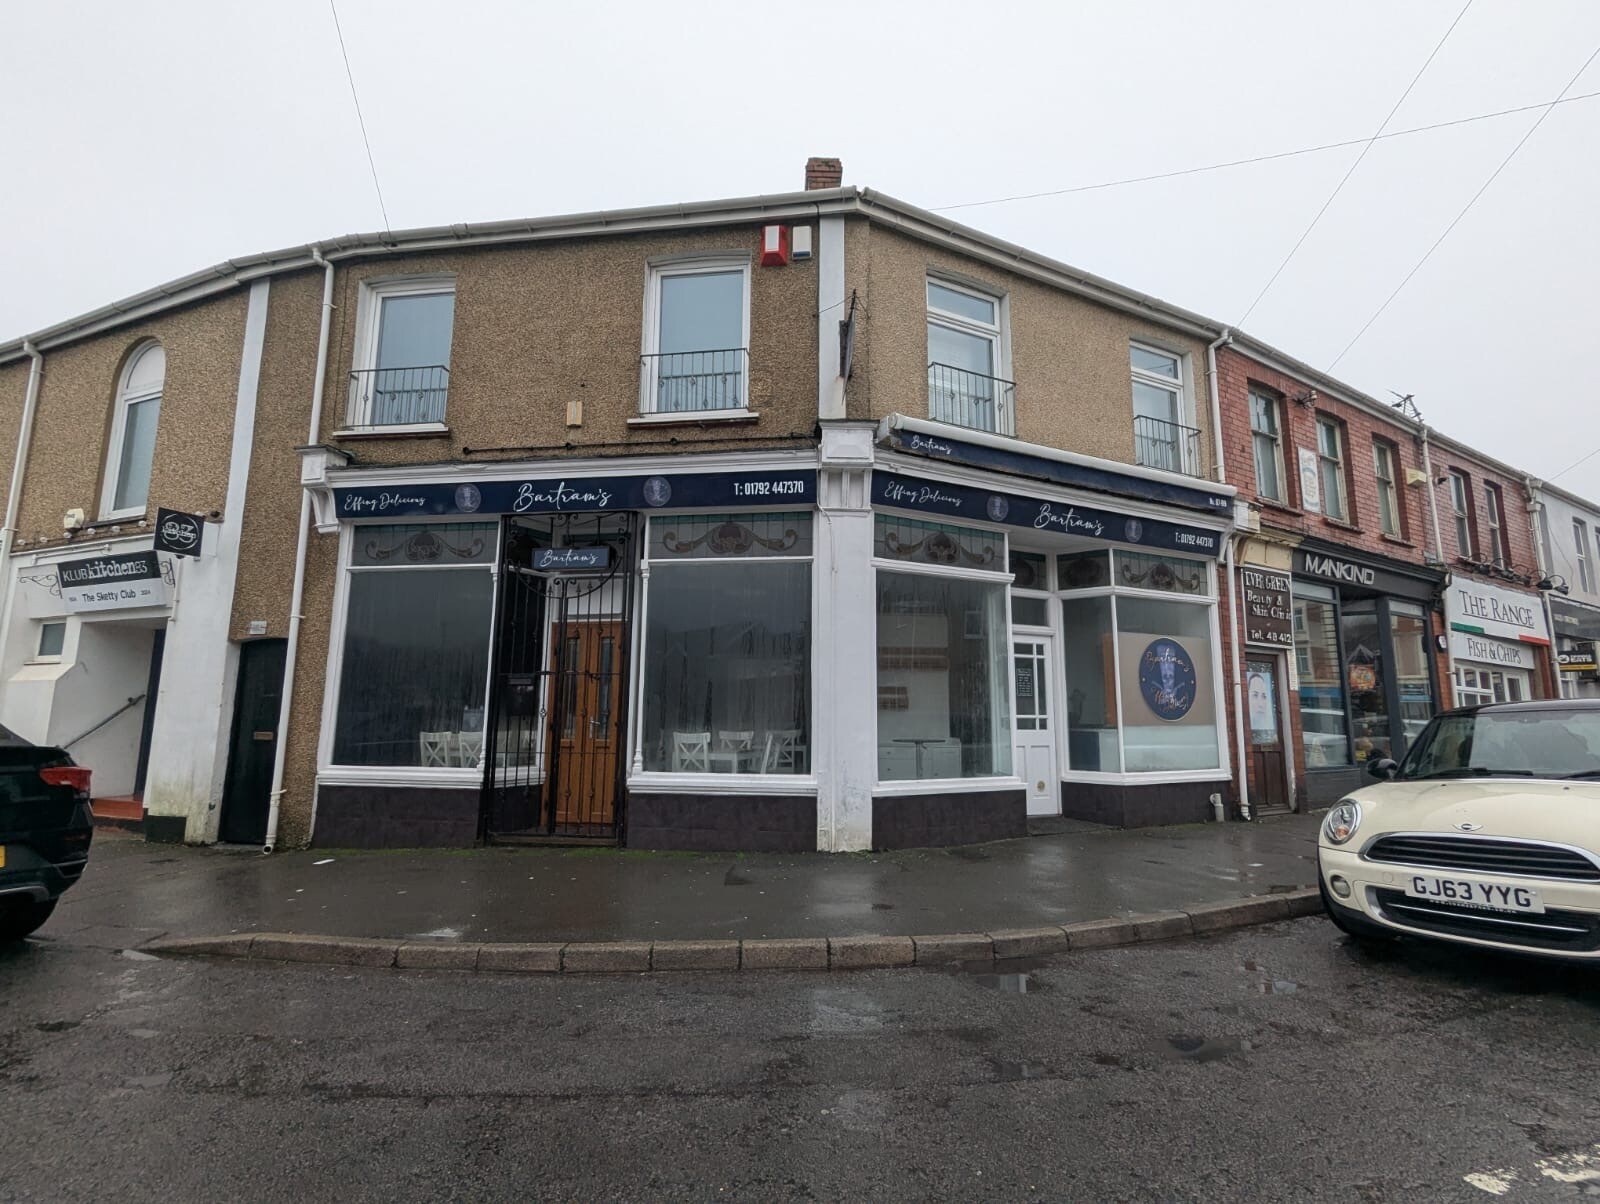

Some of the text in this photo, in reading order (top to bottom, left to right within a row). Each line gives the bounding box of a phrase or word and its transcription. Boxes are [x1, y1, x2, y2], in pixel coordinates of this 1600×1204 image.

[513, 481, 612, 512] Bartram's
[744, 482, 770, 496] 01792
[772, 480, 804, 495] 447370
[884, 481, 918, 503] Effing
[344, 494, 377, 511] Effing
[1033, 503, 1105, 535] Bartram's
[539, 549, 599, 566] Bartram's
[1305, 553, 1375, 585] MANKIND
[82, 593, 95, 603] The
[120, 589, 136, 599] Club
[1247, 590, 1283, 608] Beauty &
[1252, 603, 1269, 618] Skin
[1459, 589, 1488, 617] THE
[1490, 597, 1534, 626] RANGE
[1467, 637, 1522, 665] FISH & CHIPS
[1412, 876, 1473, 901] GJ63
[1479, 883, 1532, 909] YYG
